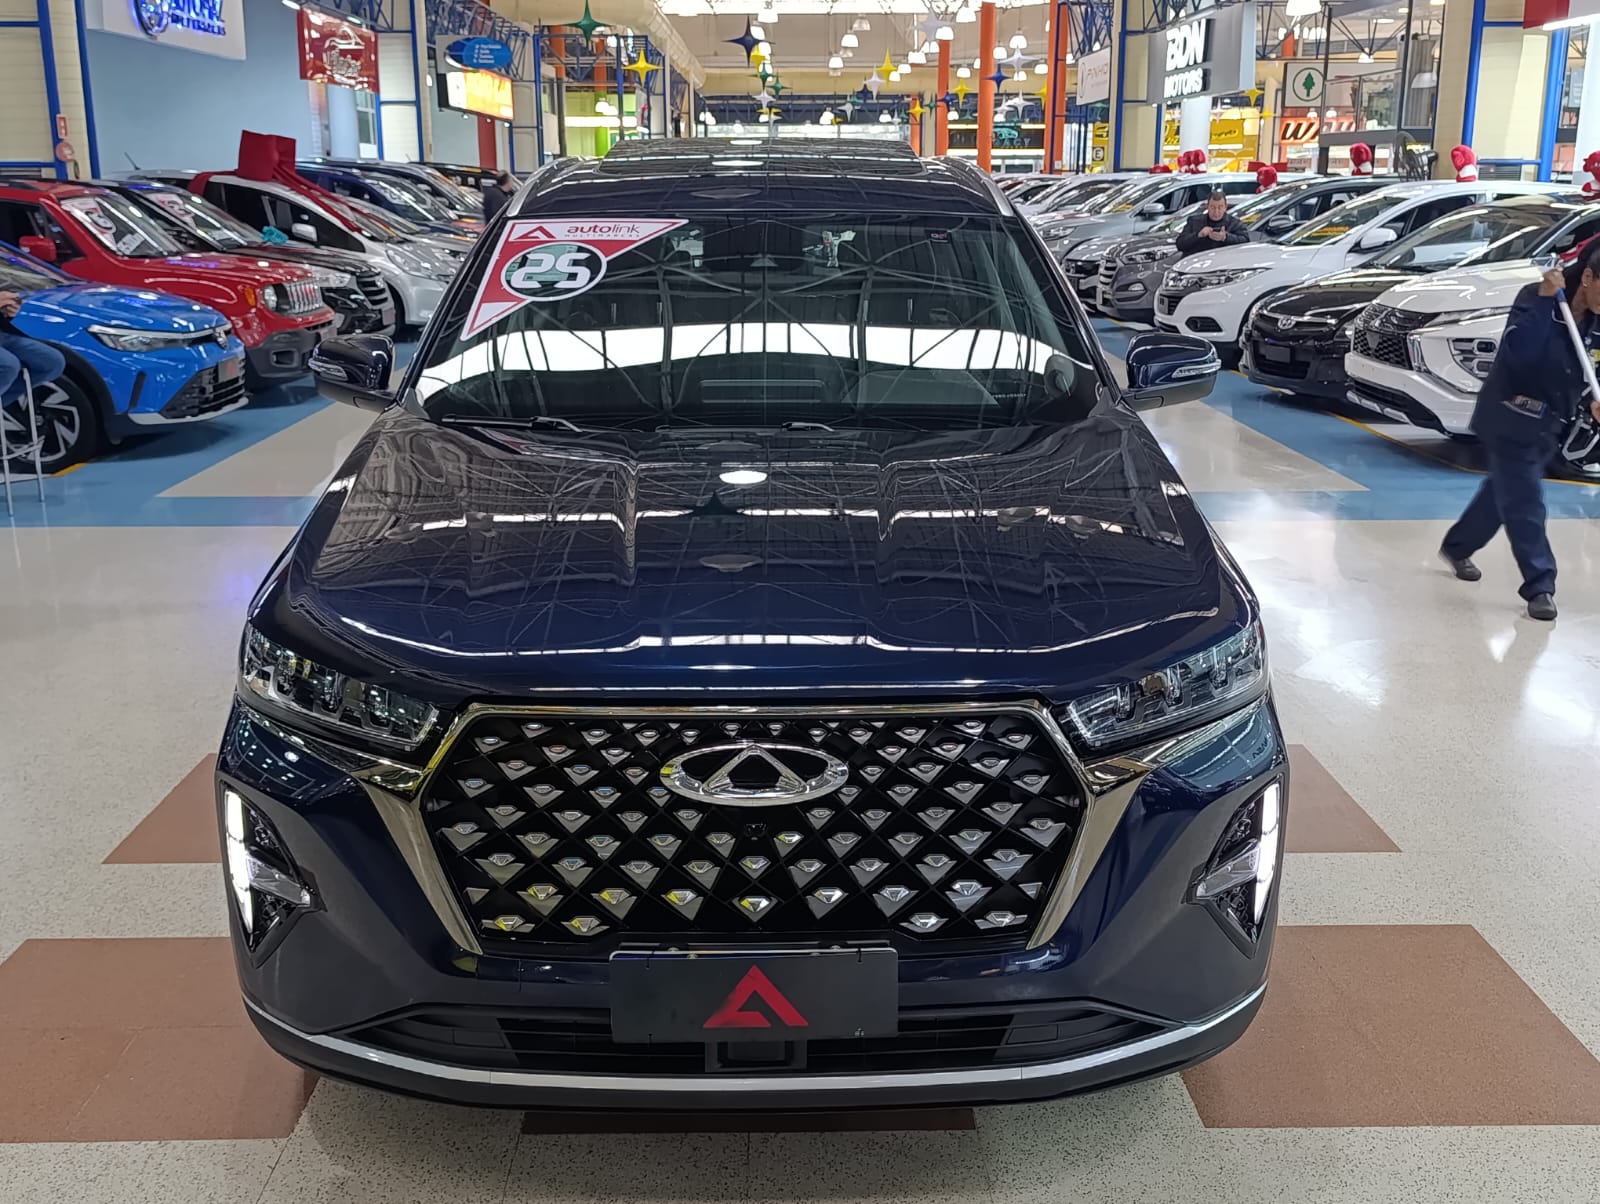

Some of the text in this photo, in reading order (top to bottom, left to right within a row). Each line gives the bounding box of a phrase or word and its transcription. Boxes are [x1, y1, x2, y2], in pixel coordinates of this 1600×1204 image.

[1166, 18, 1206, 71] BDN
[1163, 67, 1204, 98] MOTORS
[567, 224, 640, 234] autolink
[510, 253, 592, 289] 25
